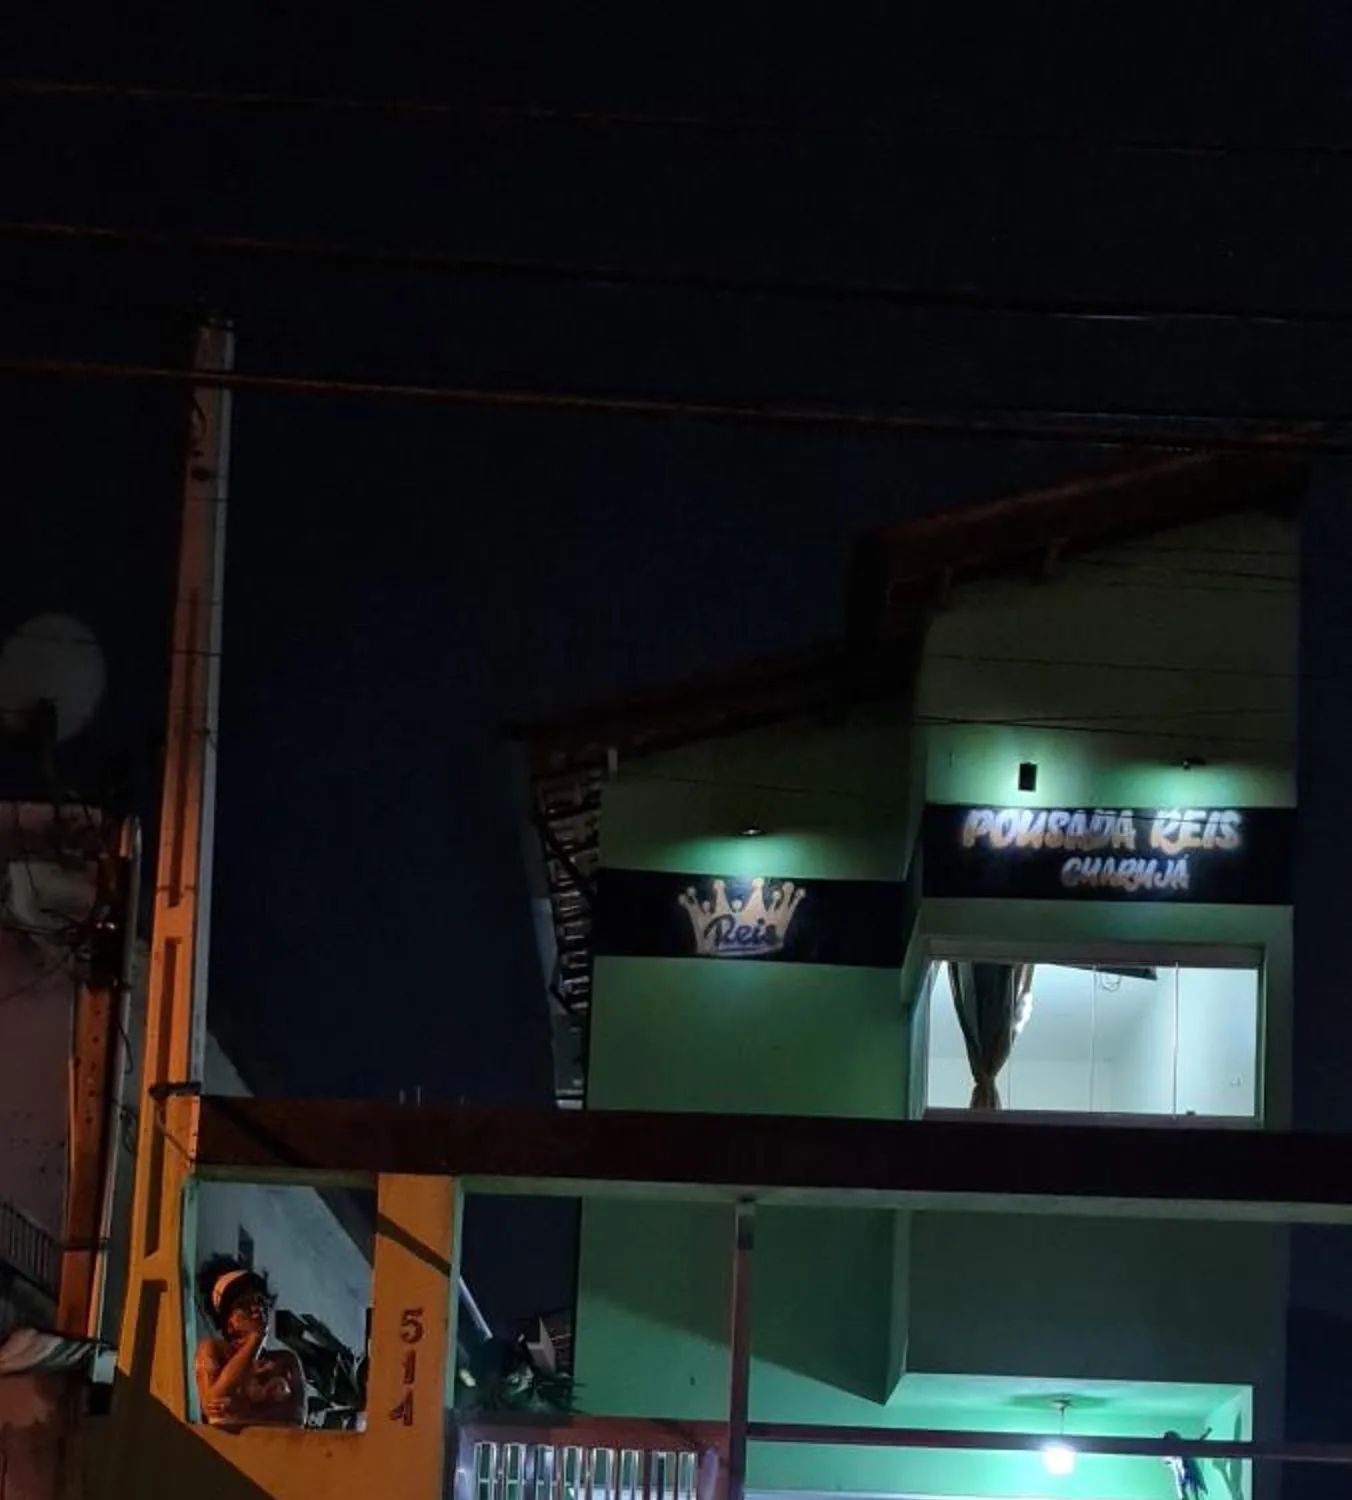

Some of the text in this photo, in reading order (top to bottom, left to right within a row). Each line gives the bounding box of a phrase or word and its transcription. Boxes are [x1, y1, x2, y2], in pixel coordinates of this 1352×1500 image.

[963, 808, 1242, 854] POUSADA REIS
[703, 913, 777, 949] Reis
[389, 1307, 424, 1427] 514
